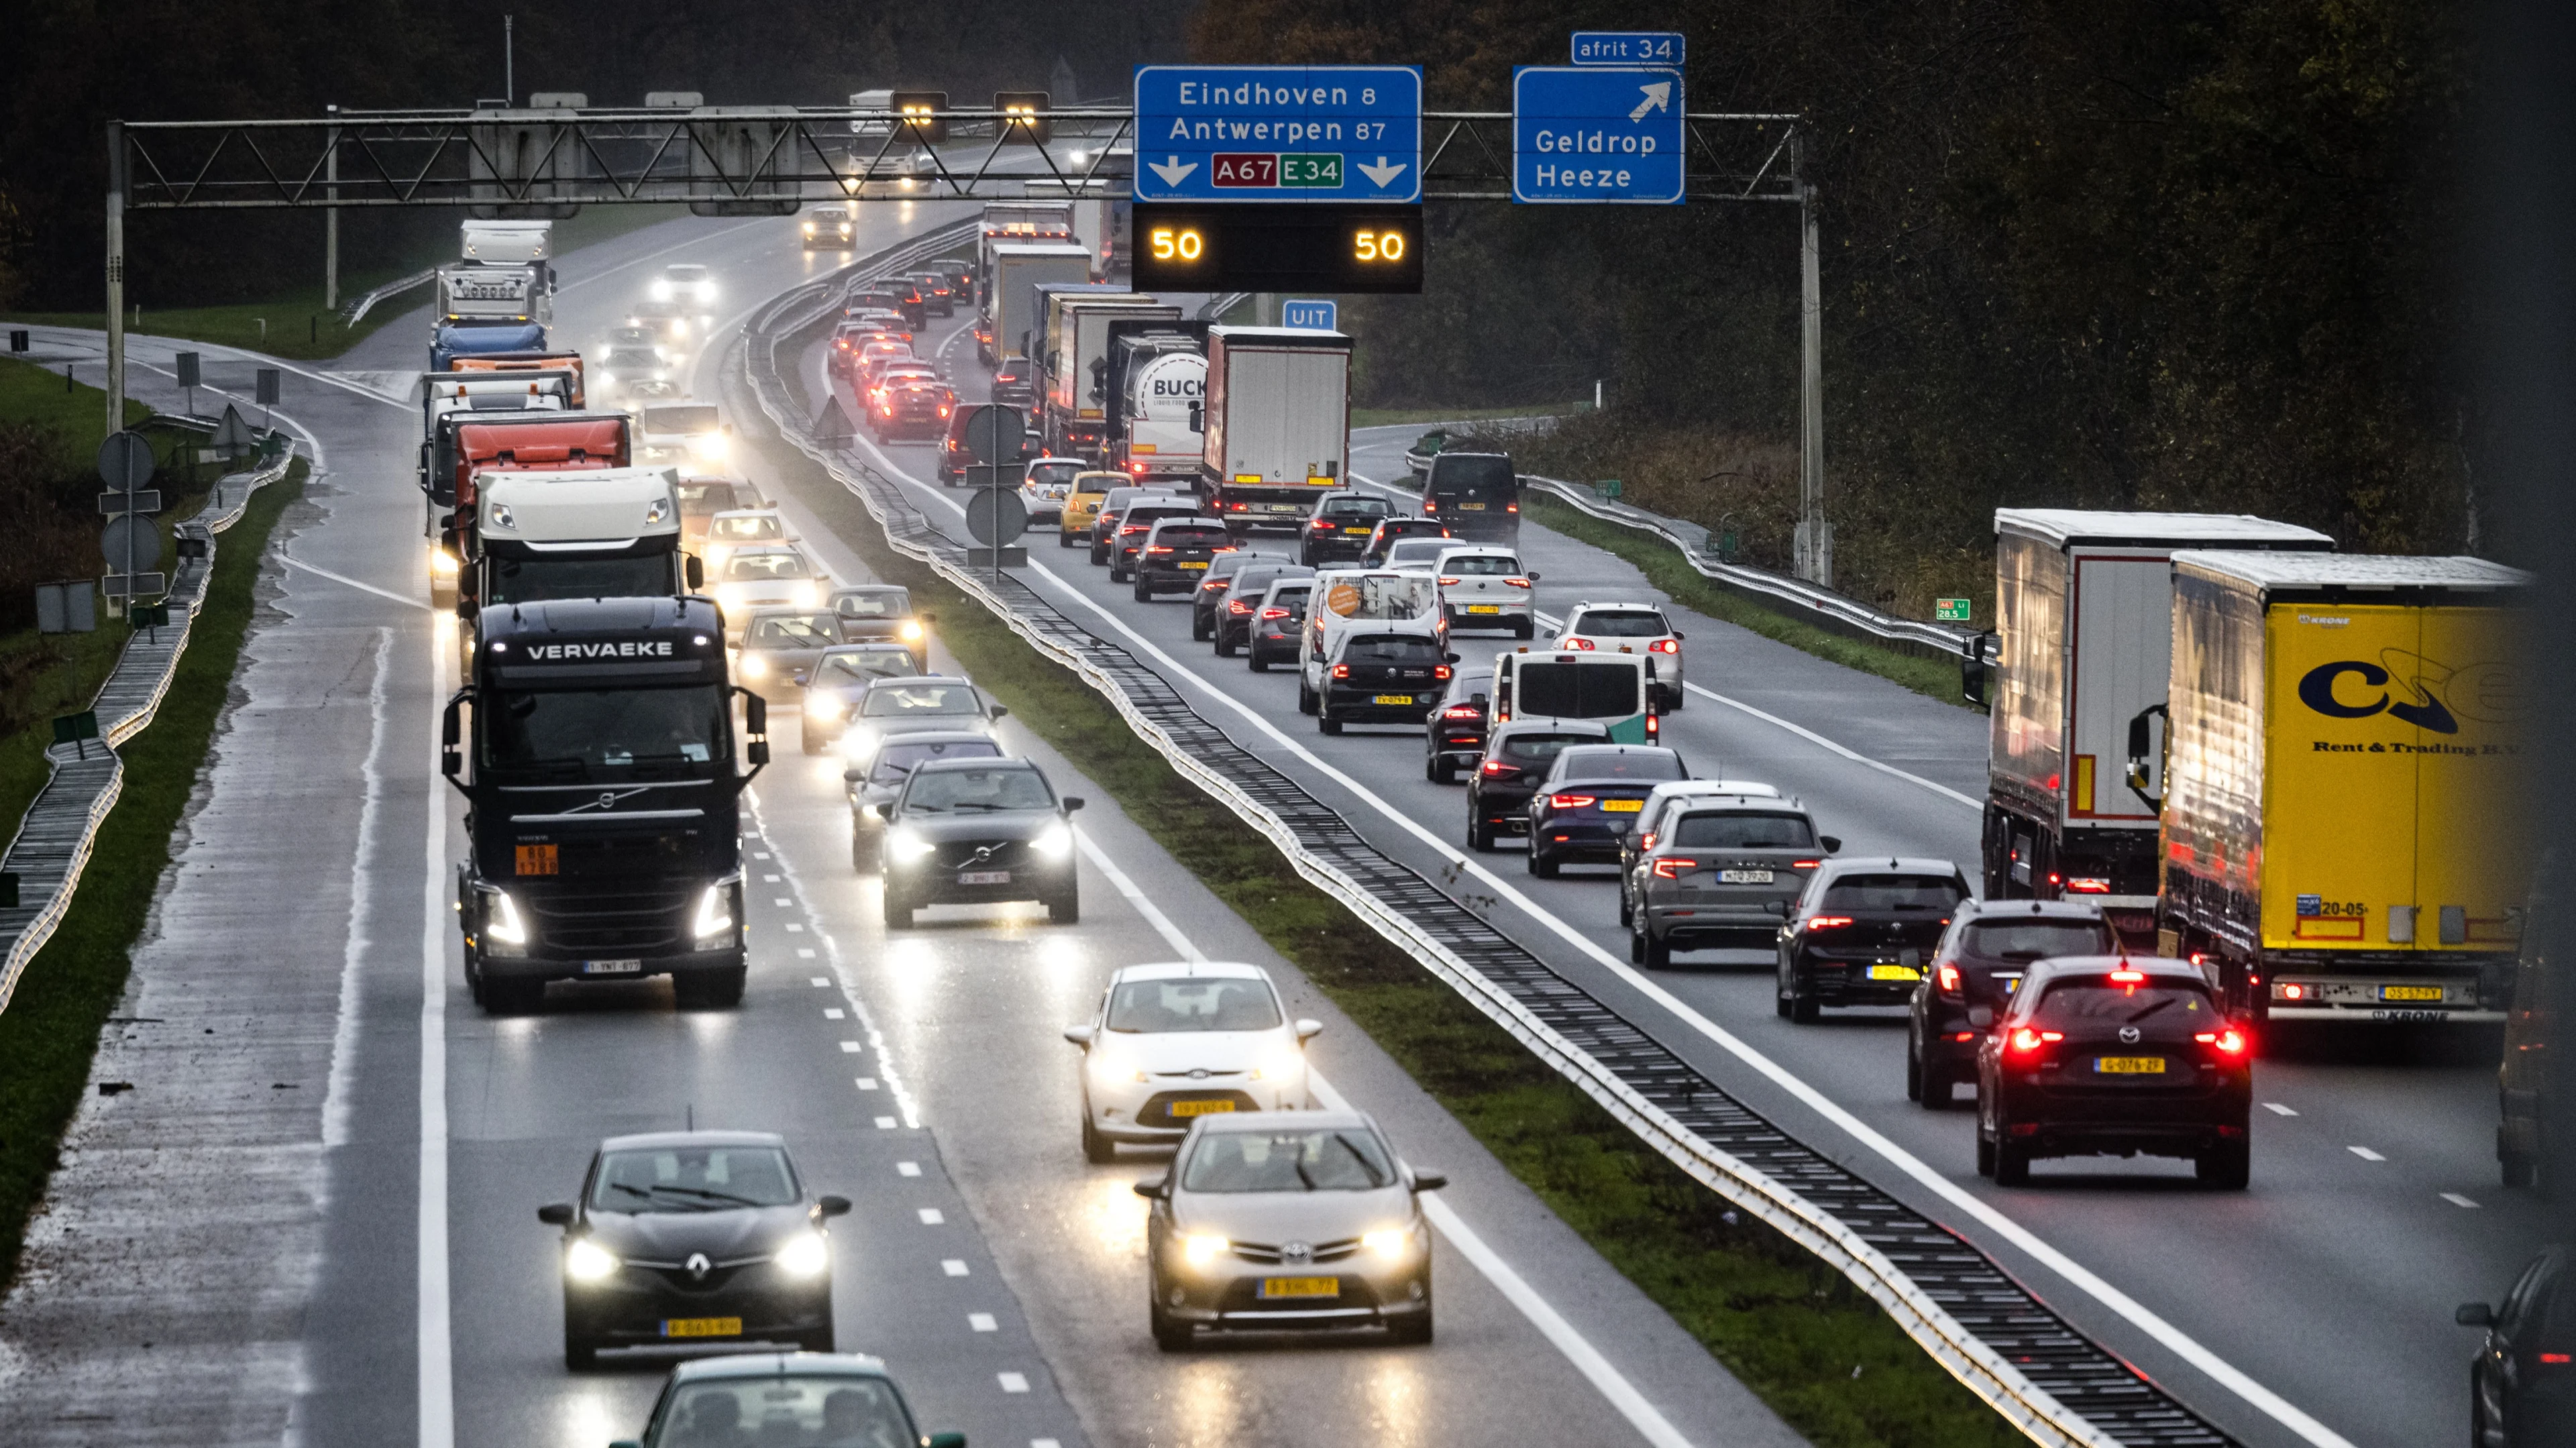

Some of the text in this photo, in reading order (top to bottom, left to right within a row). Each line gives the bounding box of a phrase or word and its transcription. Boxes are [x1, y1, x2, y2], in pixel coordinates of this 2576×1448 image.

[1580, 39, 1672, 58] afrit 34
[1180, 82, 1376, 105] Eindhoven 8
[1169, 117, 1386, 144] Antwerpen 87
[1536, 130, 1656, 158] Geldrop
[1217, 161, 1273, 180] A67
[1284, 161, 1338, 180] E34
[1537, 164, 1631, 187] Heeze
[1152, 231, 1202, 260] 50
[1354, 232, 1403, 260] 50
[1293, 309, 1327, 325] UIT
[1155, 380, 1208, 396] BUCK
[527, 642, 673, 660] VERVAEKE
[2312, 742, 2365, 752] Rent
[2368, 742, 2385, 753] &
[2390, 742, 2477, 757] Trading
[2322, 901, 2364, 915] 20-05
[2386, 1011, 2449, 1022] KRONE
